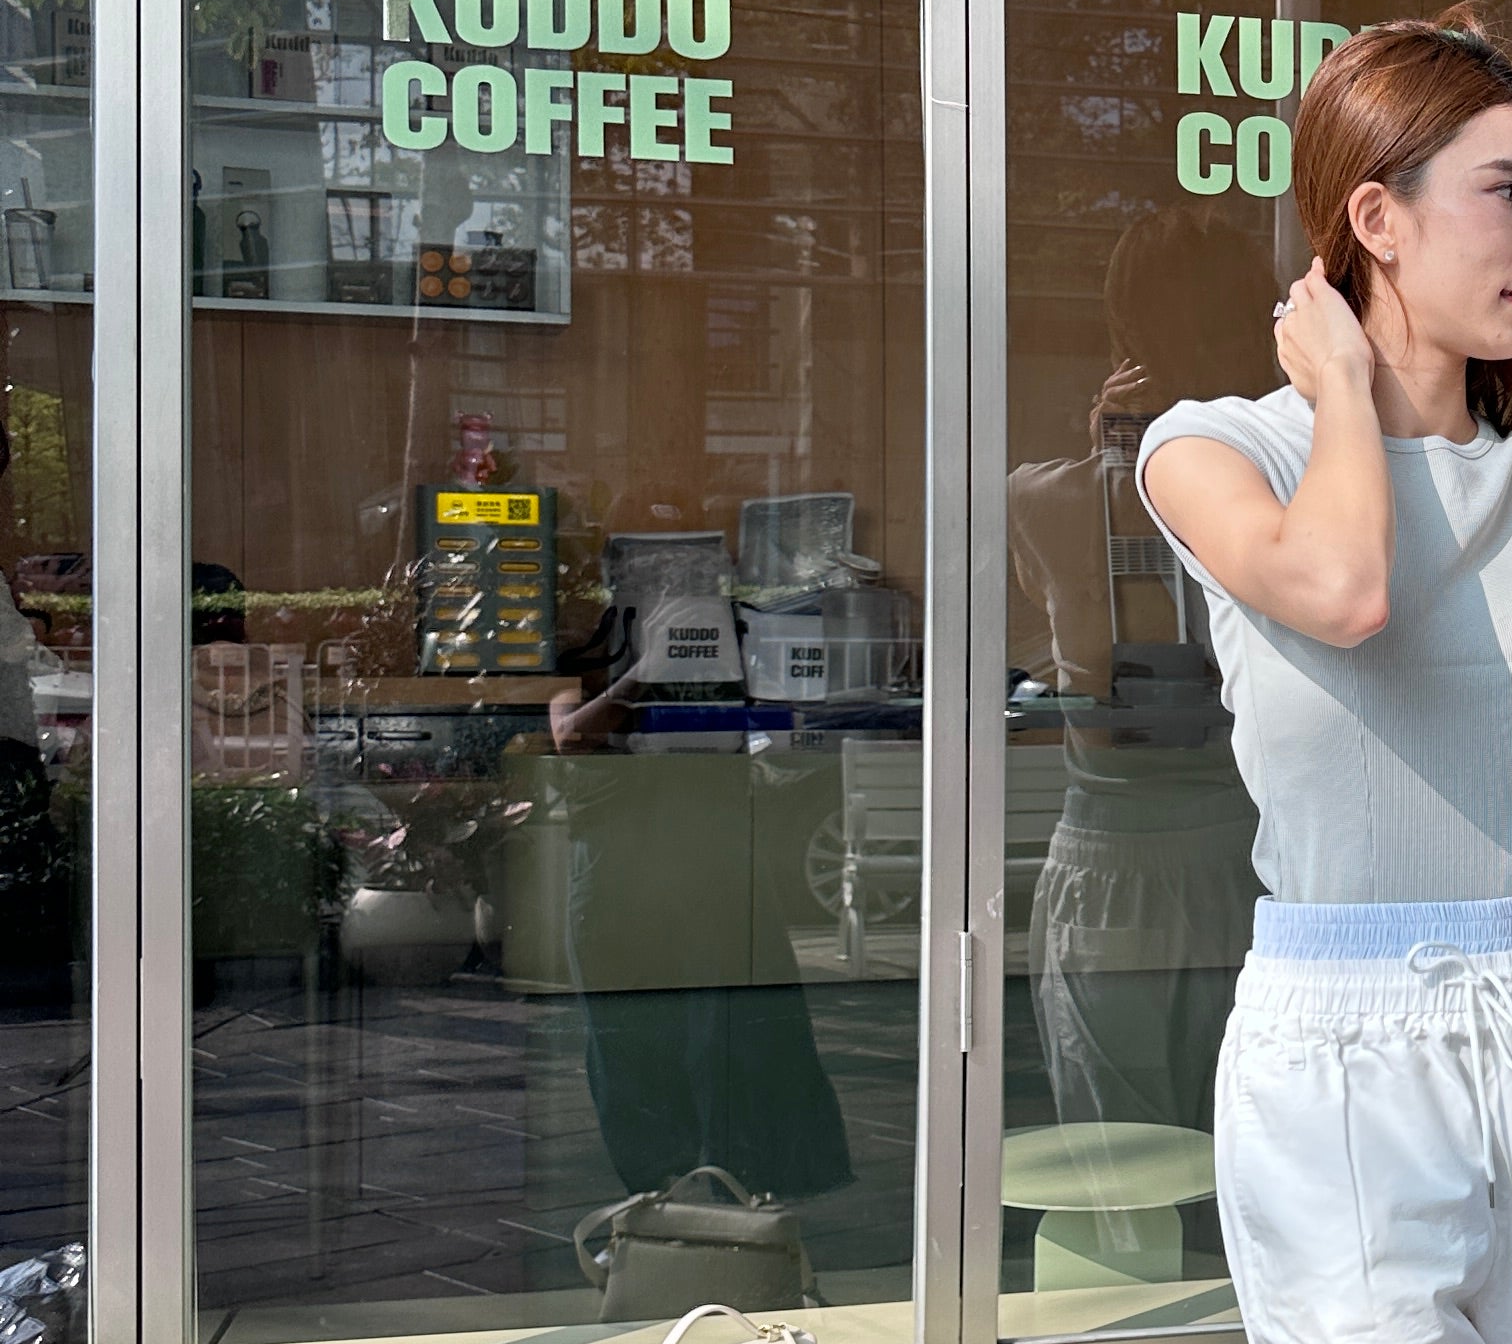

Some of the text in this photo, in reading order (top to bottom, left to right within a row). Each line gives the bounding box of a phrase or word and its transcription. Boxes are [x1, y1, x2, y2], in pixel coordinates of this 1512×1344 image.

[1176, 11, 1374, 101] KUD
[381, 60, 735, 166] COFFEE
[668, 627, 720, 642] KUDDO
[667, 644, 720, 659] COFFEE
[790, 646, 825, 661] KUD
[790, 664, 825, 679] COFF
